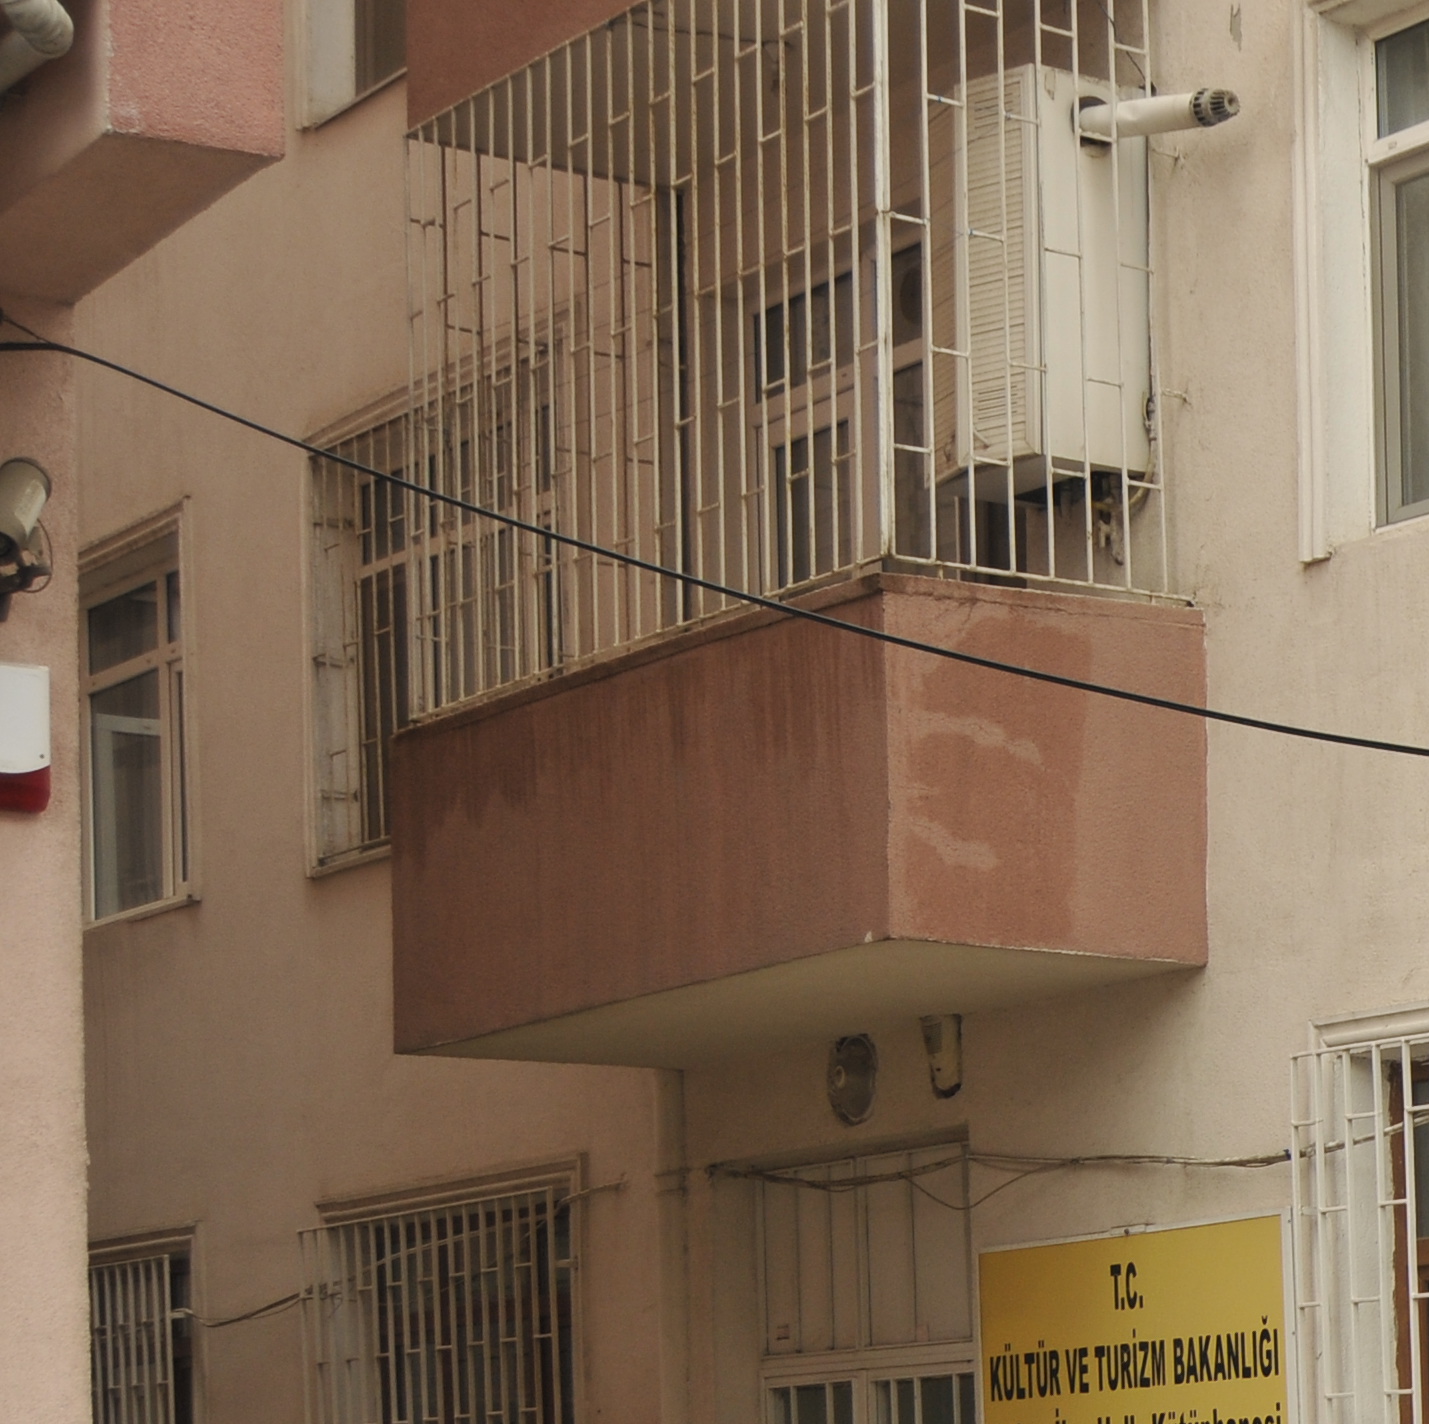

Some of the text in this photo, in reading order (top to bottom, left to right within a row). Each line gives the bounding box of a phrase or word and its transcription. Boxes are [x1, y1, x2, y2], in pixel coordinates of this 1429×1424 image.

[1110, 1262, 1143, 1310] T.C.
[990, 1315, 1279, 1401] KÜLTÜR VE TURİZM BAKANLIĞI
